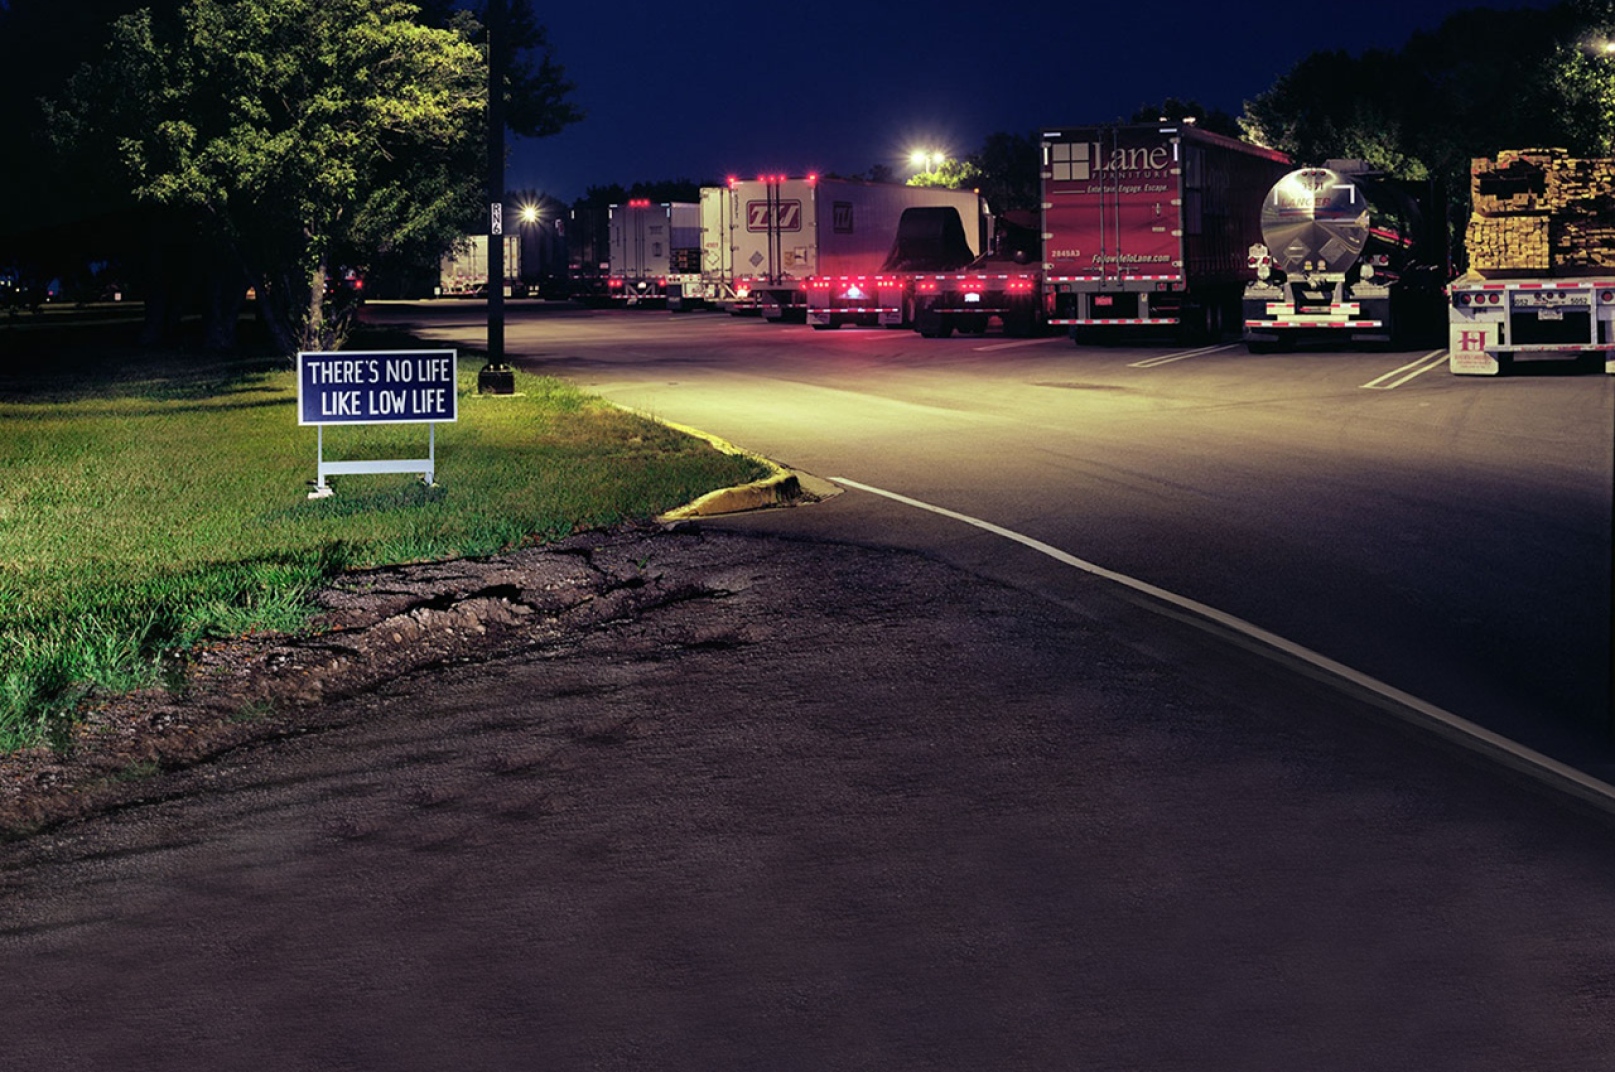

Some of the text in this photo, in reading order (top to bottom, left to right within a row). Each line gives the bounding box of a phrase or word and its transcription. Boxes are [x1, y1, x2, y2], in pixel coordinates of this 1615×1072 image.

[1092, 142, 1168, 171] Lane
[1092, 254, 1171, 264] FolowMeToLane.com
[307, 358, 450, 384] THERE'S NO LIFE
[321, 388, 446, 415] LIKE LOW LIFE
